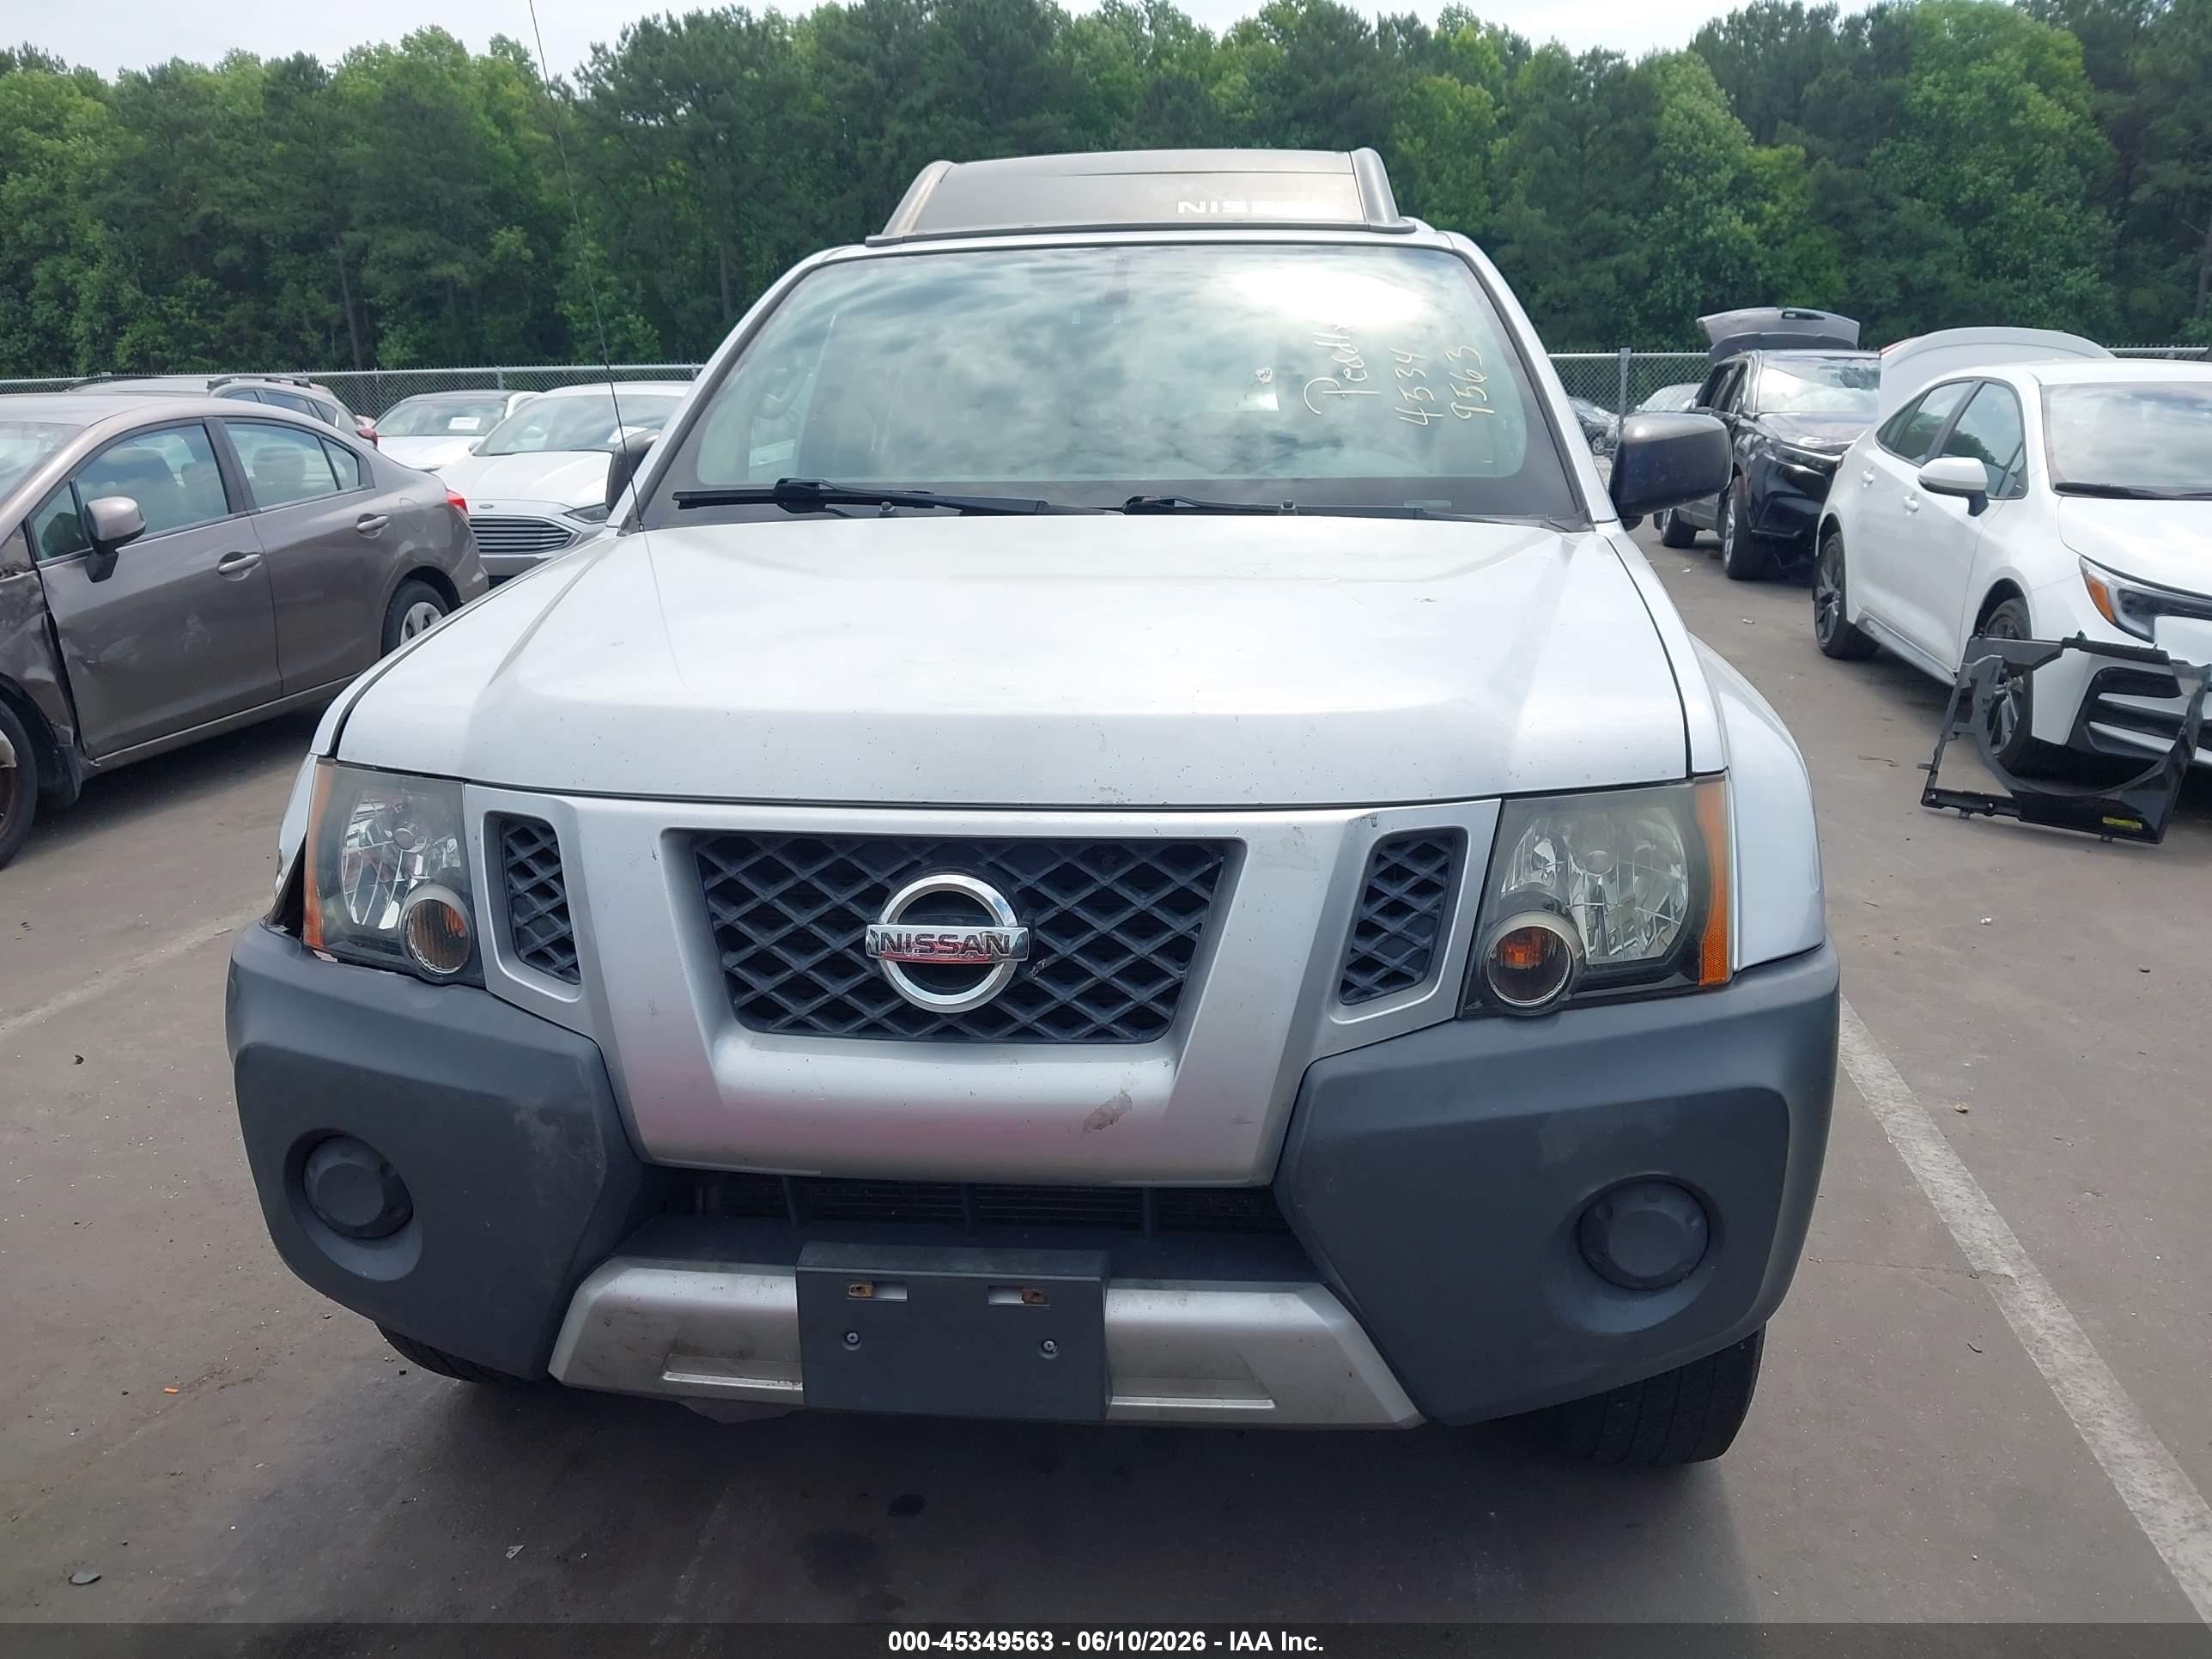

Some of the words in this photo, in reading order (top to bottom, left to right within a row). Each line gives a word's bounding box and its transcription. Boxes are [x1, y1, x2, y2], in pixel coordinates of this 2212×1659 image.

[1389, 347, 1444, 426] 4534
[1443, 344, 1495, 420] 9563
[879, 932, 1011, 957] NISSAN
